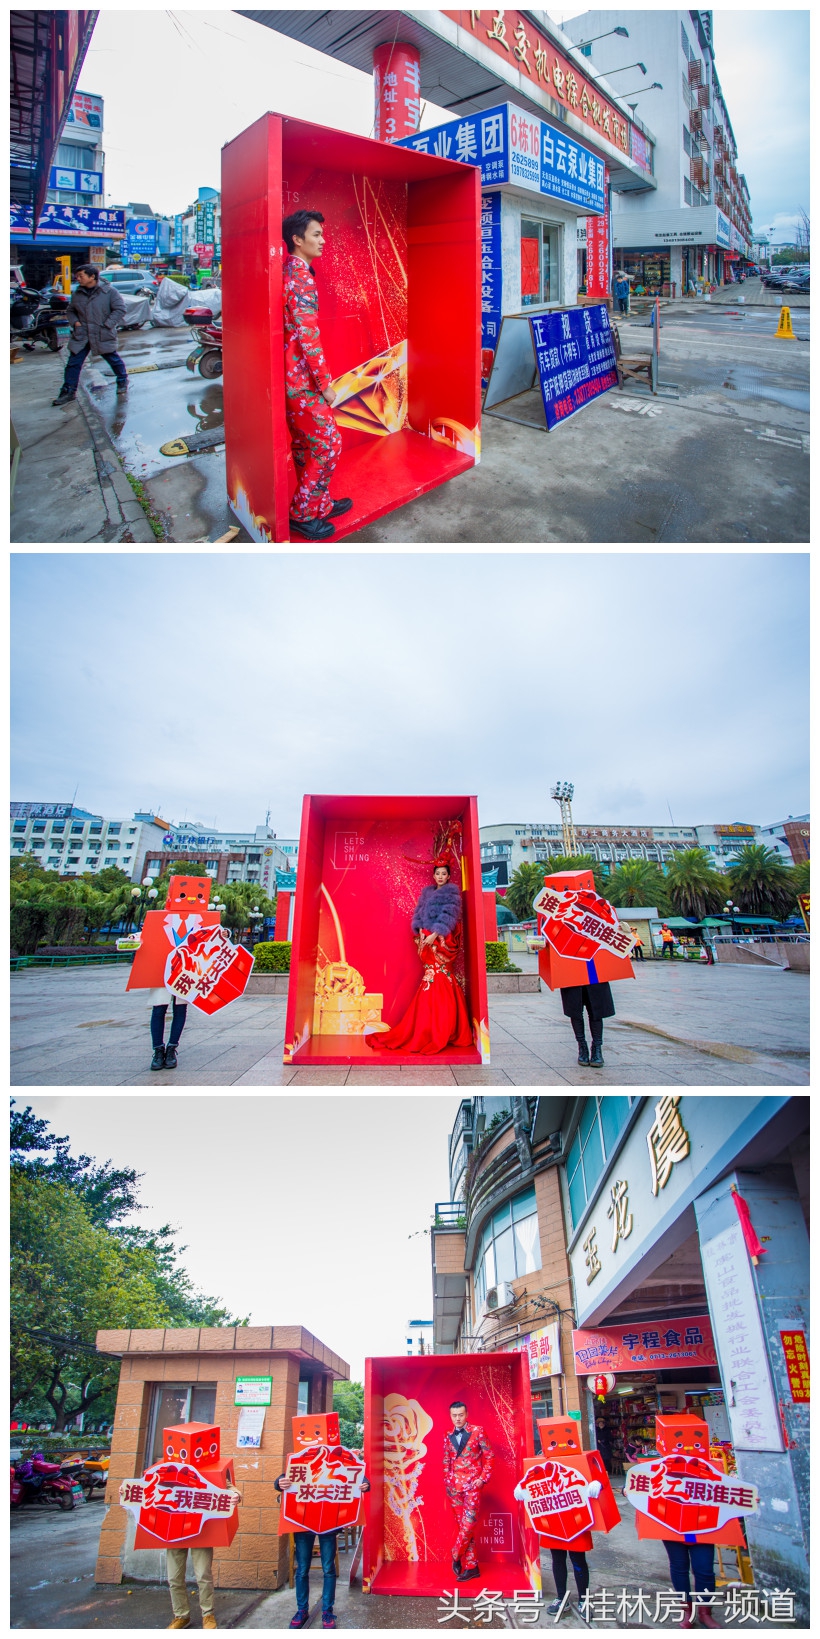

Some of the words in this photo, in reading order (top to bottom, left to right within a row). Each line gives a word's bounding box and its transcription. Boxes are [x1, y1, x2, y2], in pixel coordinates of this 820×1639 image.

[511, 114, 540, 157] 6栋16
[543, 129, 605, 194] 白云泵业集团
[177, 836, 215, 845] 桂林银行
[343, 845, 354, 853] SH
[344, 837, 365, 845] LETS
[344, 853, 369, 861] INING
[538, 892, 632, 953] 谁红跟谁走
[195, 945, 237, 996] 求关注
[622, 1327, 703, 1350] 宇程食品
[289, 1447, 363, 1484] 我红了
[123, 1473, 232, 1512] 谁红我要谁
[298, 1484, 353, 1500] 求关注
[528, 1463, 586, 1499] 我敢红
[629, 1463, 753, 1508] 谁红跟谁走
[527, 1489, 583, 1515] 你敢拍吗
[483, 1519, 504, 1527] LETS
[493, 1527, 504, 1536] SH
[480, 1537, 505, 1545] INING
